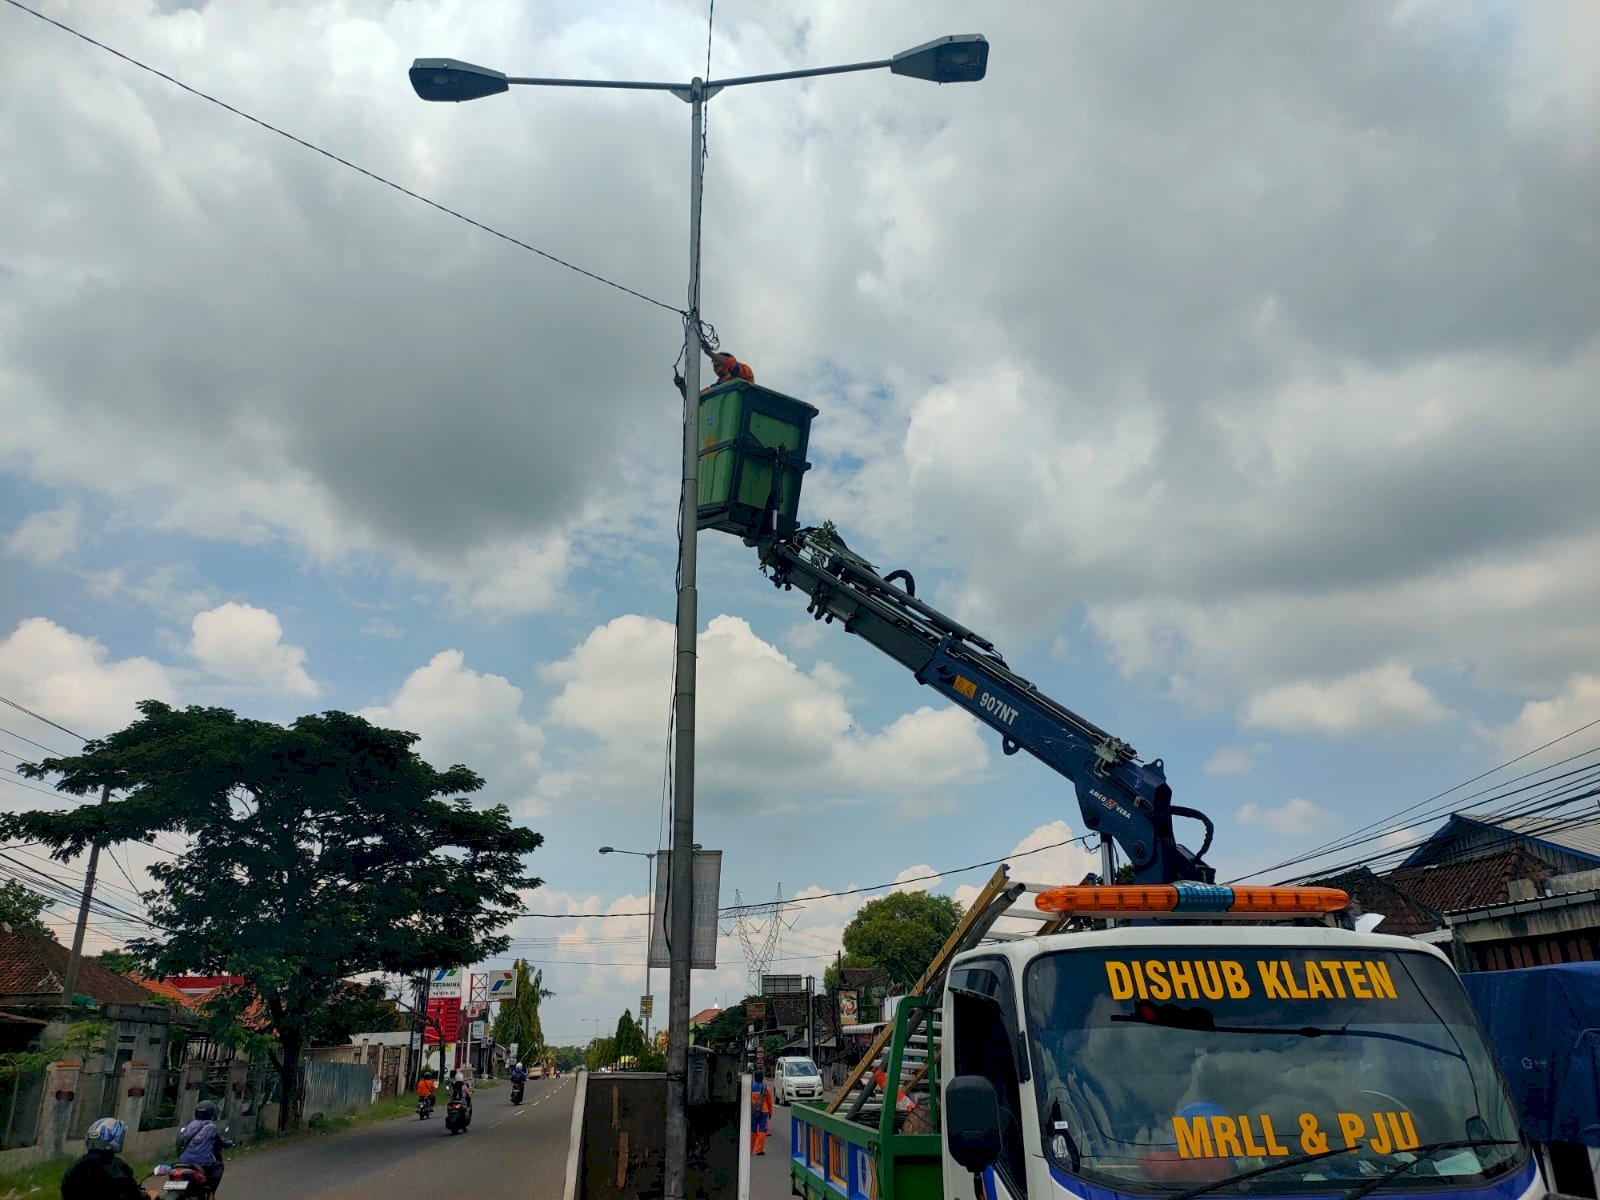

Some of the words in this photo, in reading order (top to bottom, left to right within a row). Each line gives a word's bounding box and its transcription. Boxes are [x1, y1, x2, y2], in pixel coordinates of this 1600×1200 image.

[980, 692, 1019, 726] 907NT
[1089, 789, 1107, 802] AMCO
[1116, 805, 1131, 819] VEBA
[1105, 960, 1250, 1000] DISHUB
[1257, 960, 1398, 999] KLATEN
[1172, 1114, 1289, 1159] MRLL
[1298, 1112, 1329, 1156] &
[1337, 1112, 1420, 1155] PJU
